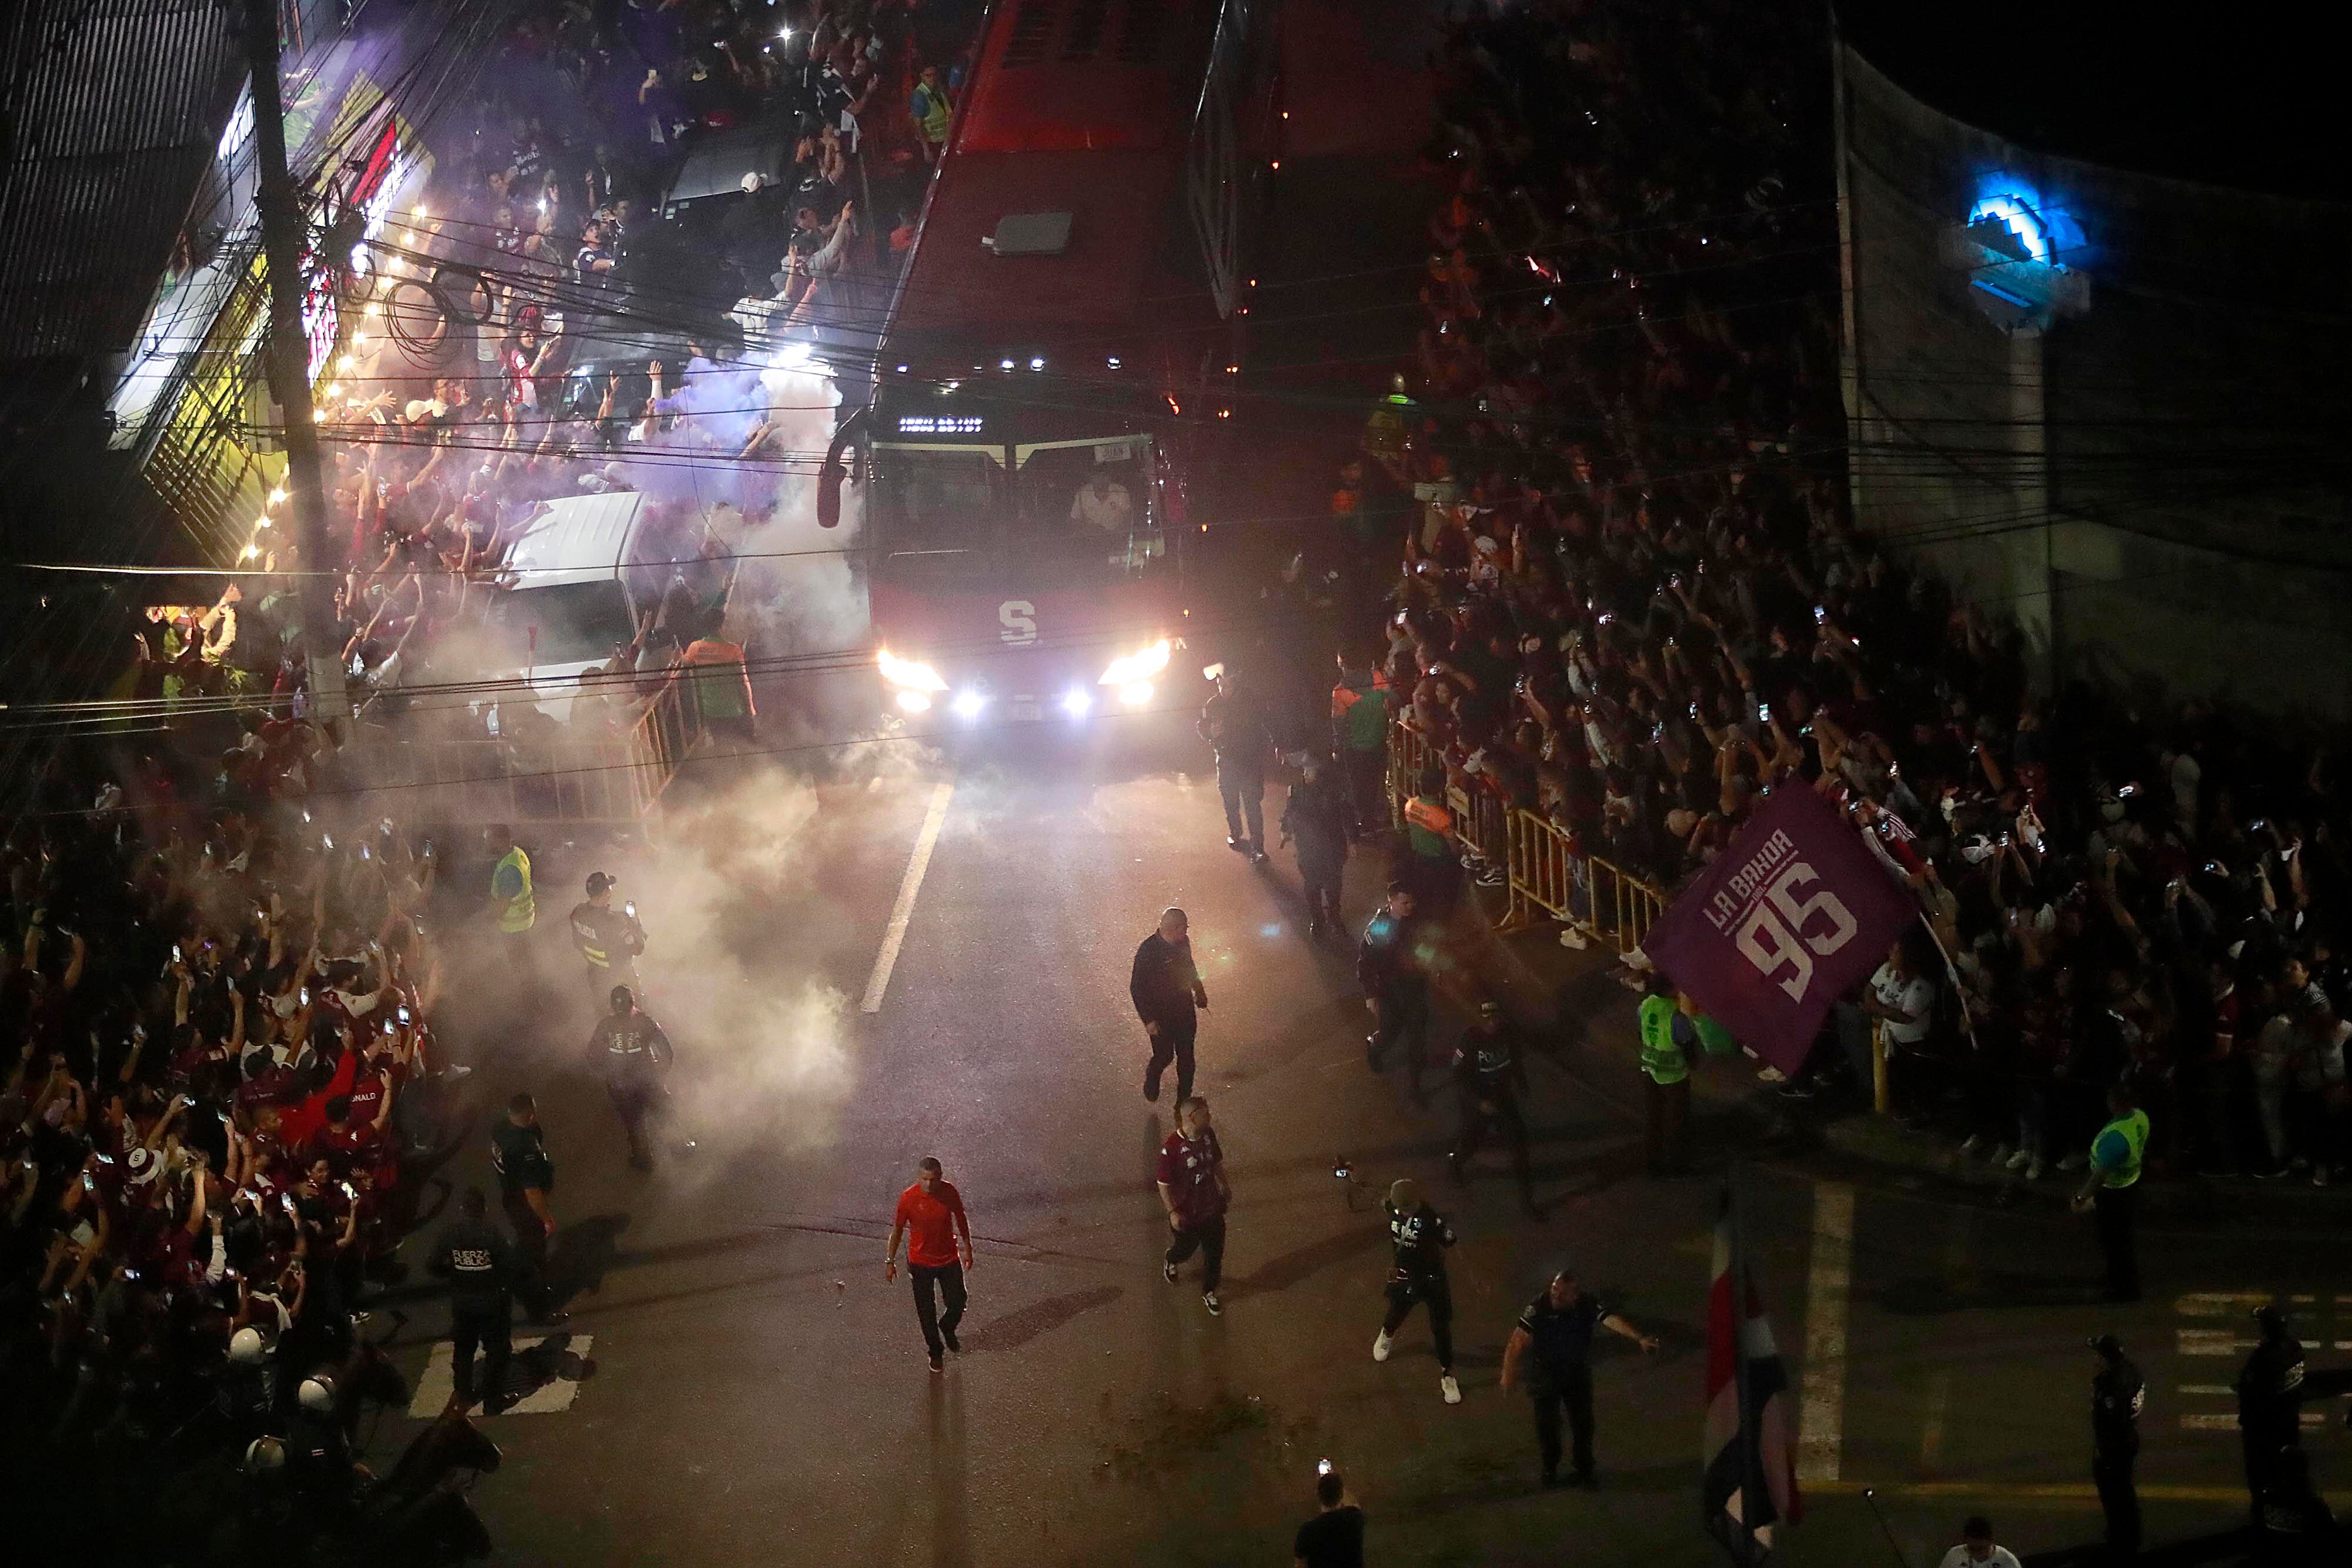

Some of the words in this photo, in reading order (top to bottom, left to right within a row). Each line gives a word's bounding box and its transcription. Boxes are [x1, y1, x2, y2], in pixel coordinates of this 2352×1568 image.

[1000, 600, 1037, 645] S
[1702, 890, 1738, 930] LA
[1728, 828, 1794, 901] BANDA
[1736, 862, 1857, 1004] 95
